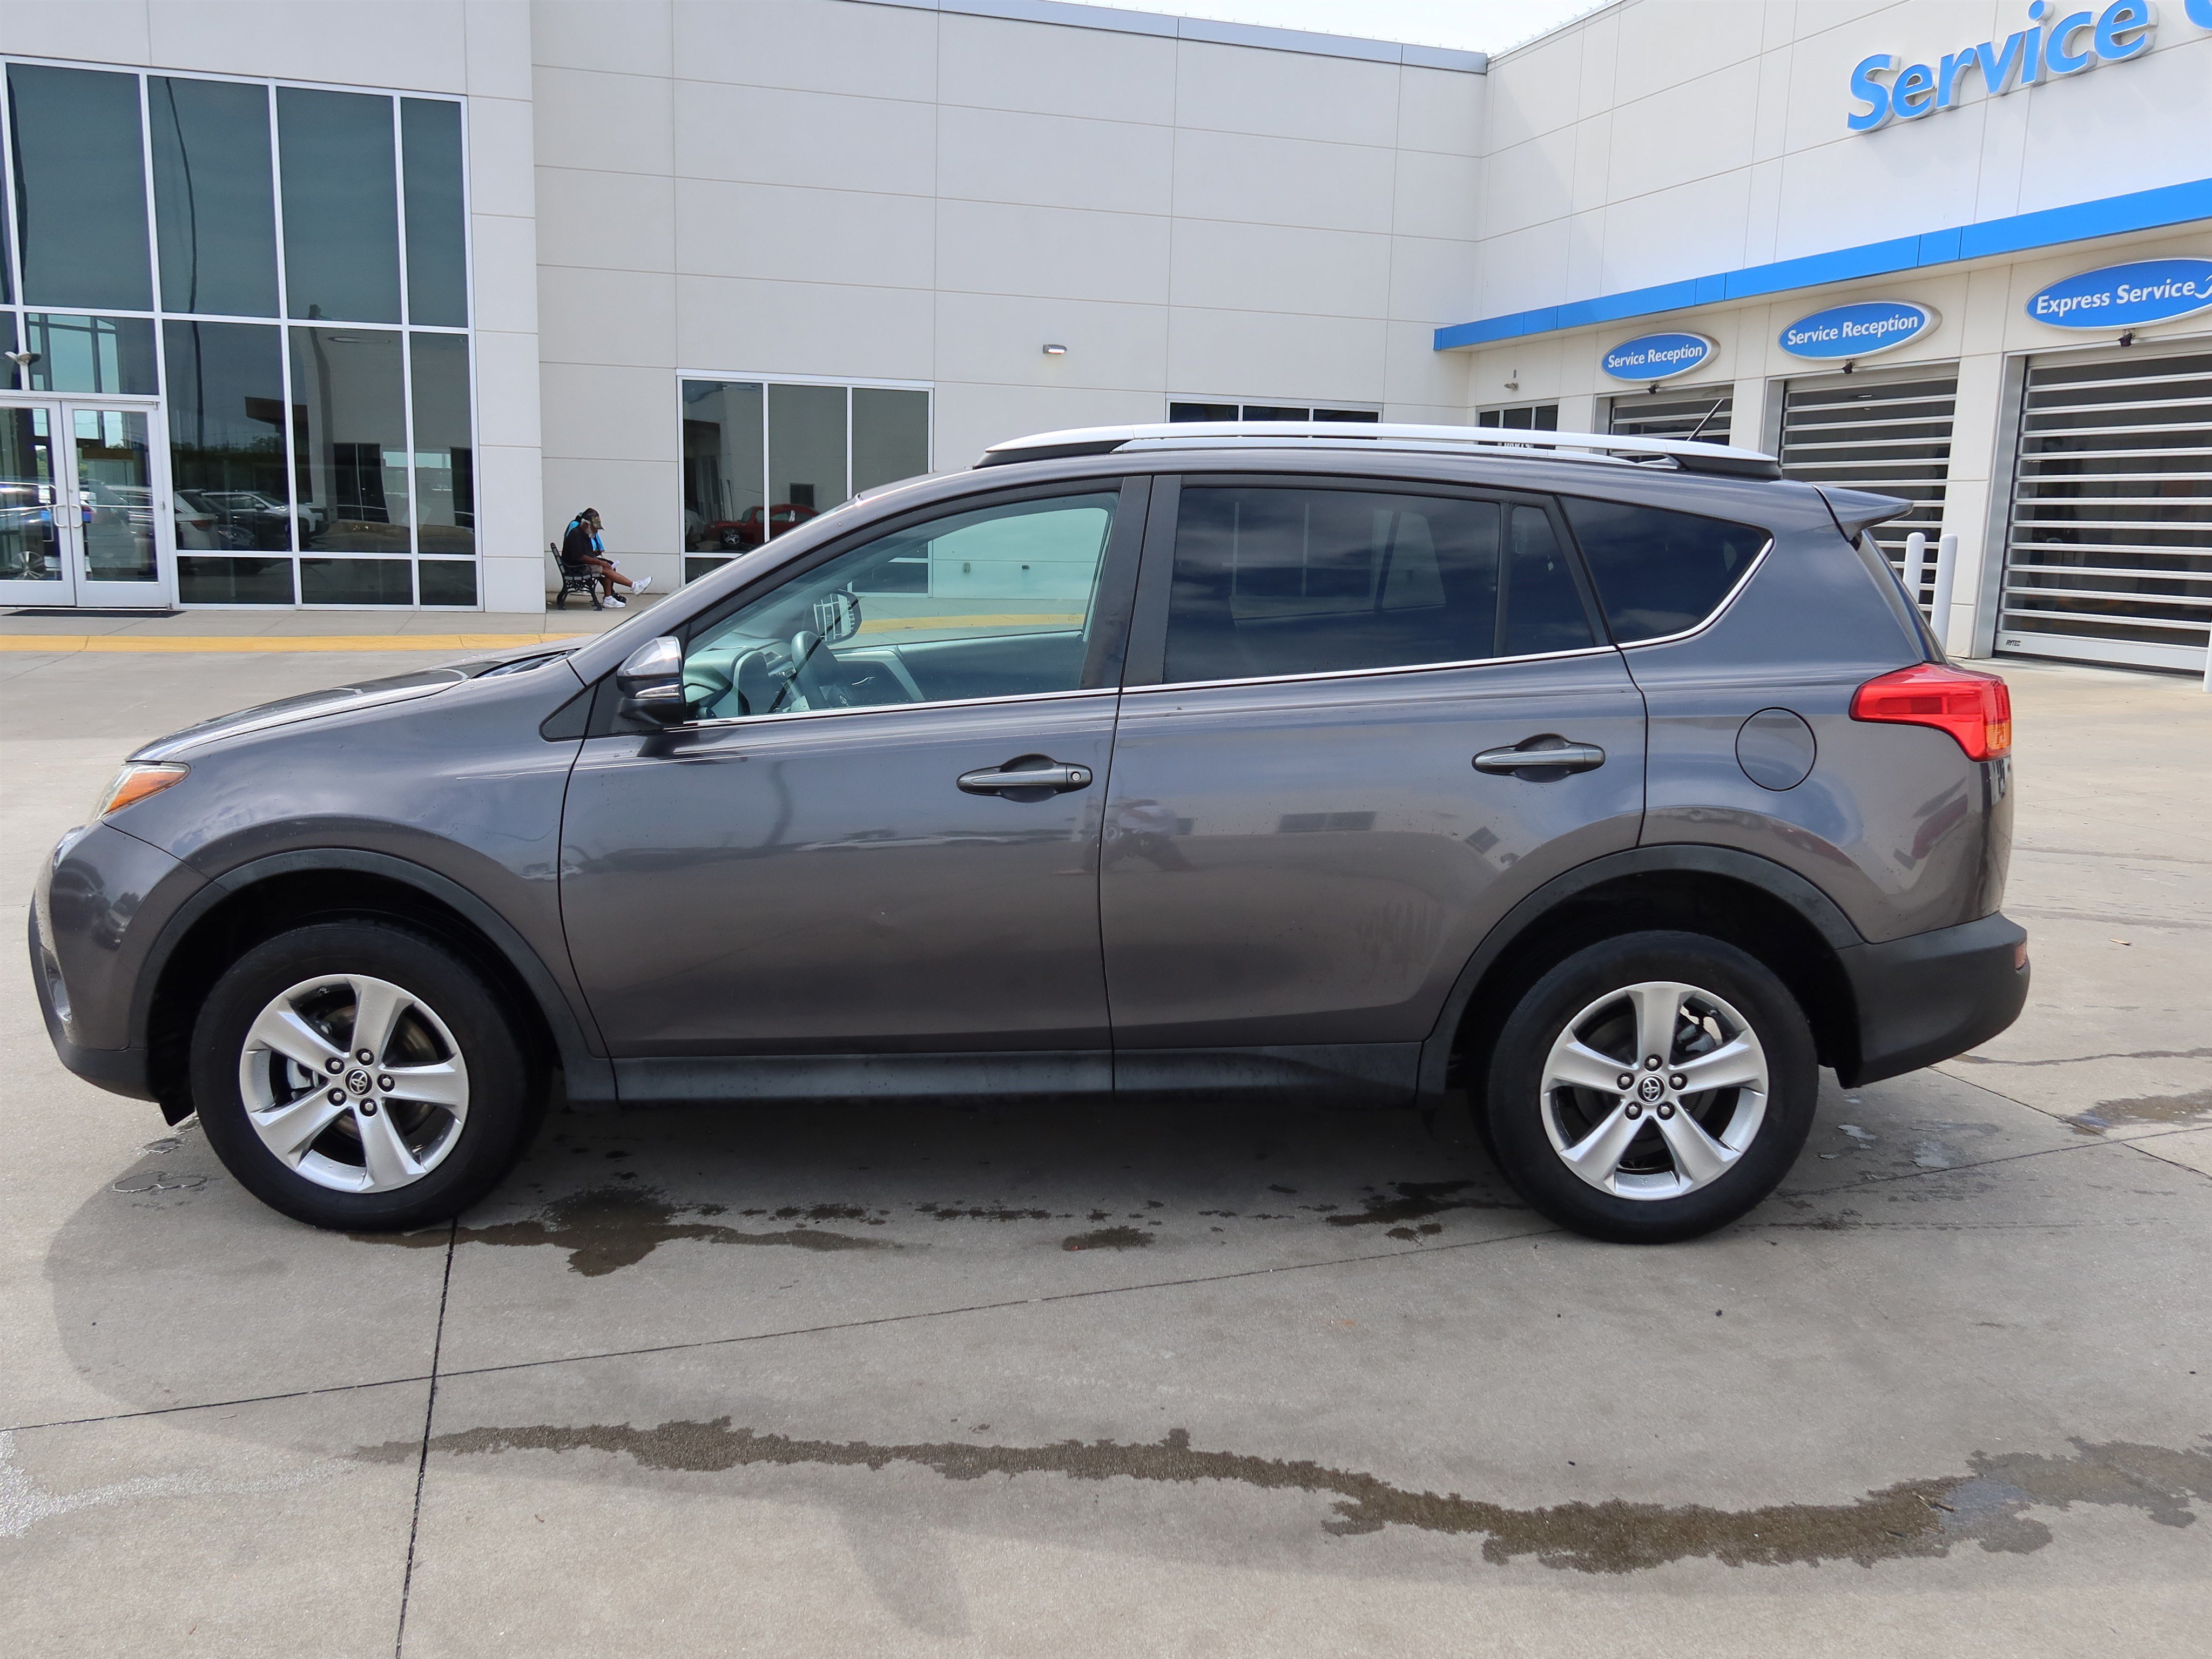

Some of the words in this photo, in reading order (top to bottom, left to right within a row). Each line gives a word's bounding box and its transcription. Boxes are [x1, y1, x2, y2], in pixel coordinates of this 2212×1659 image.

[1847, 0, 2154, 132] Service
[2036, 293, 2110, 317] Express
[2116, 278, 2196, 304] Service
[1787, 325, 1839, 346] Service
[1842, 314, 1918, 338] Reception
[1608, 352, 1645, 368] Service
[1647, 343, 1703, 364] Reception
